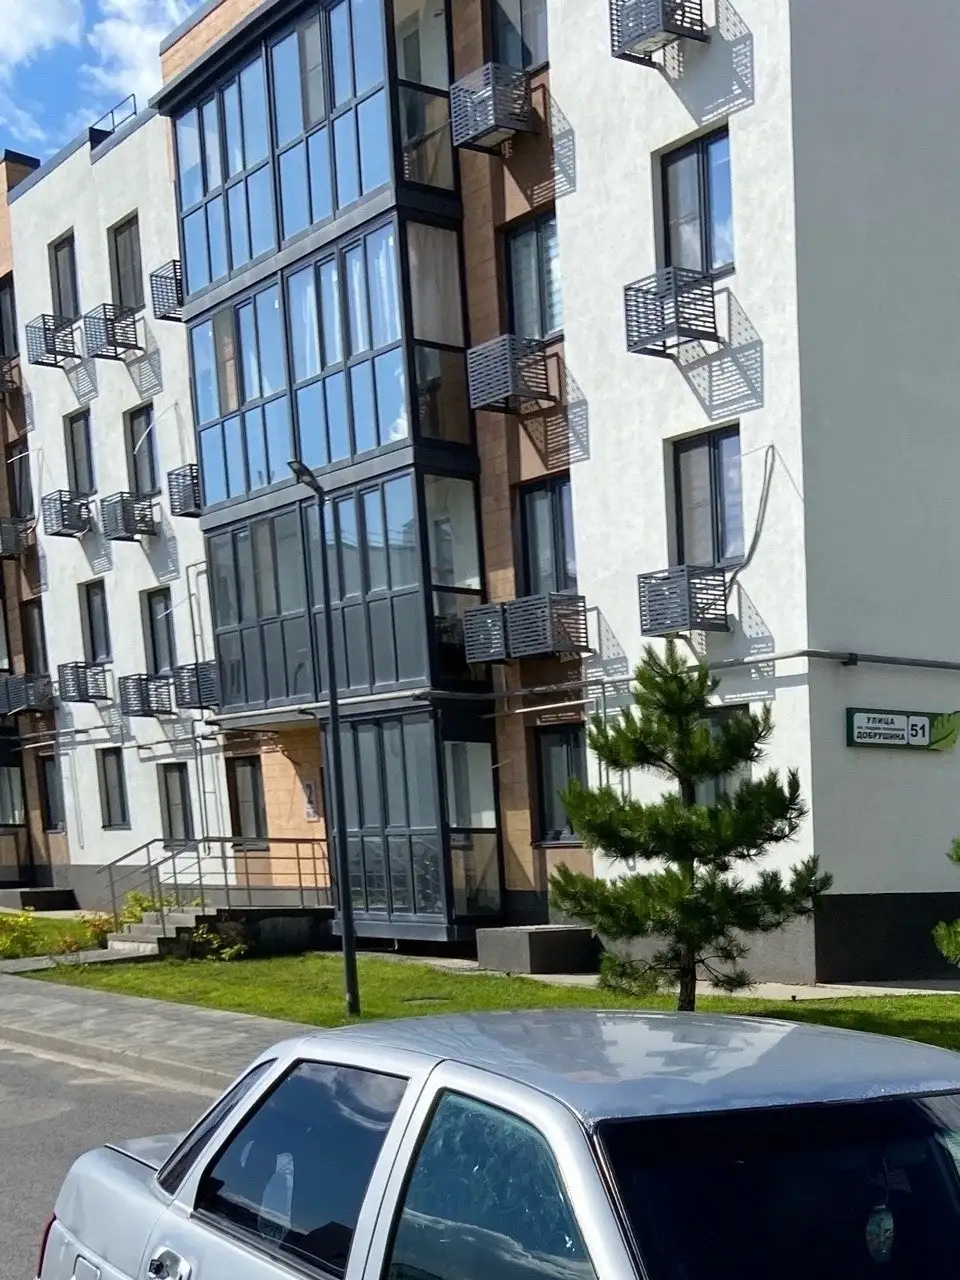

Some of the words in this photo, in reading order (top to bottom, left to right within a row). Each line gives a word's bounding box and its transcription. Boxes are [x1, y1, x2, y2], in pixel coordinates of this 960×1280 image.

[866, 716, 895, 725] УЛИЦА
[856, 731, 905, 741] ДОБРУШИНА
[910, 724, 926, 738] 51
